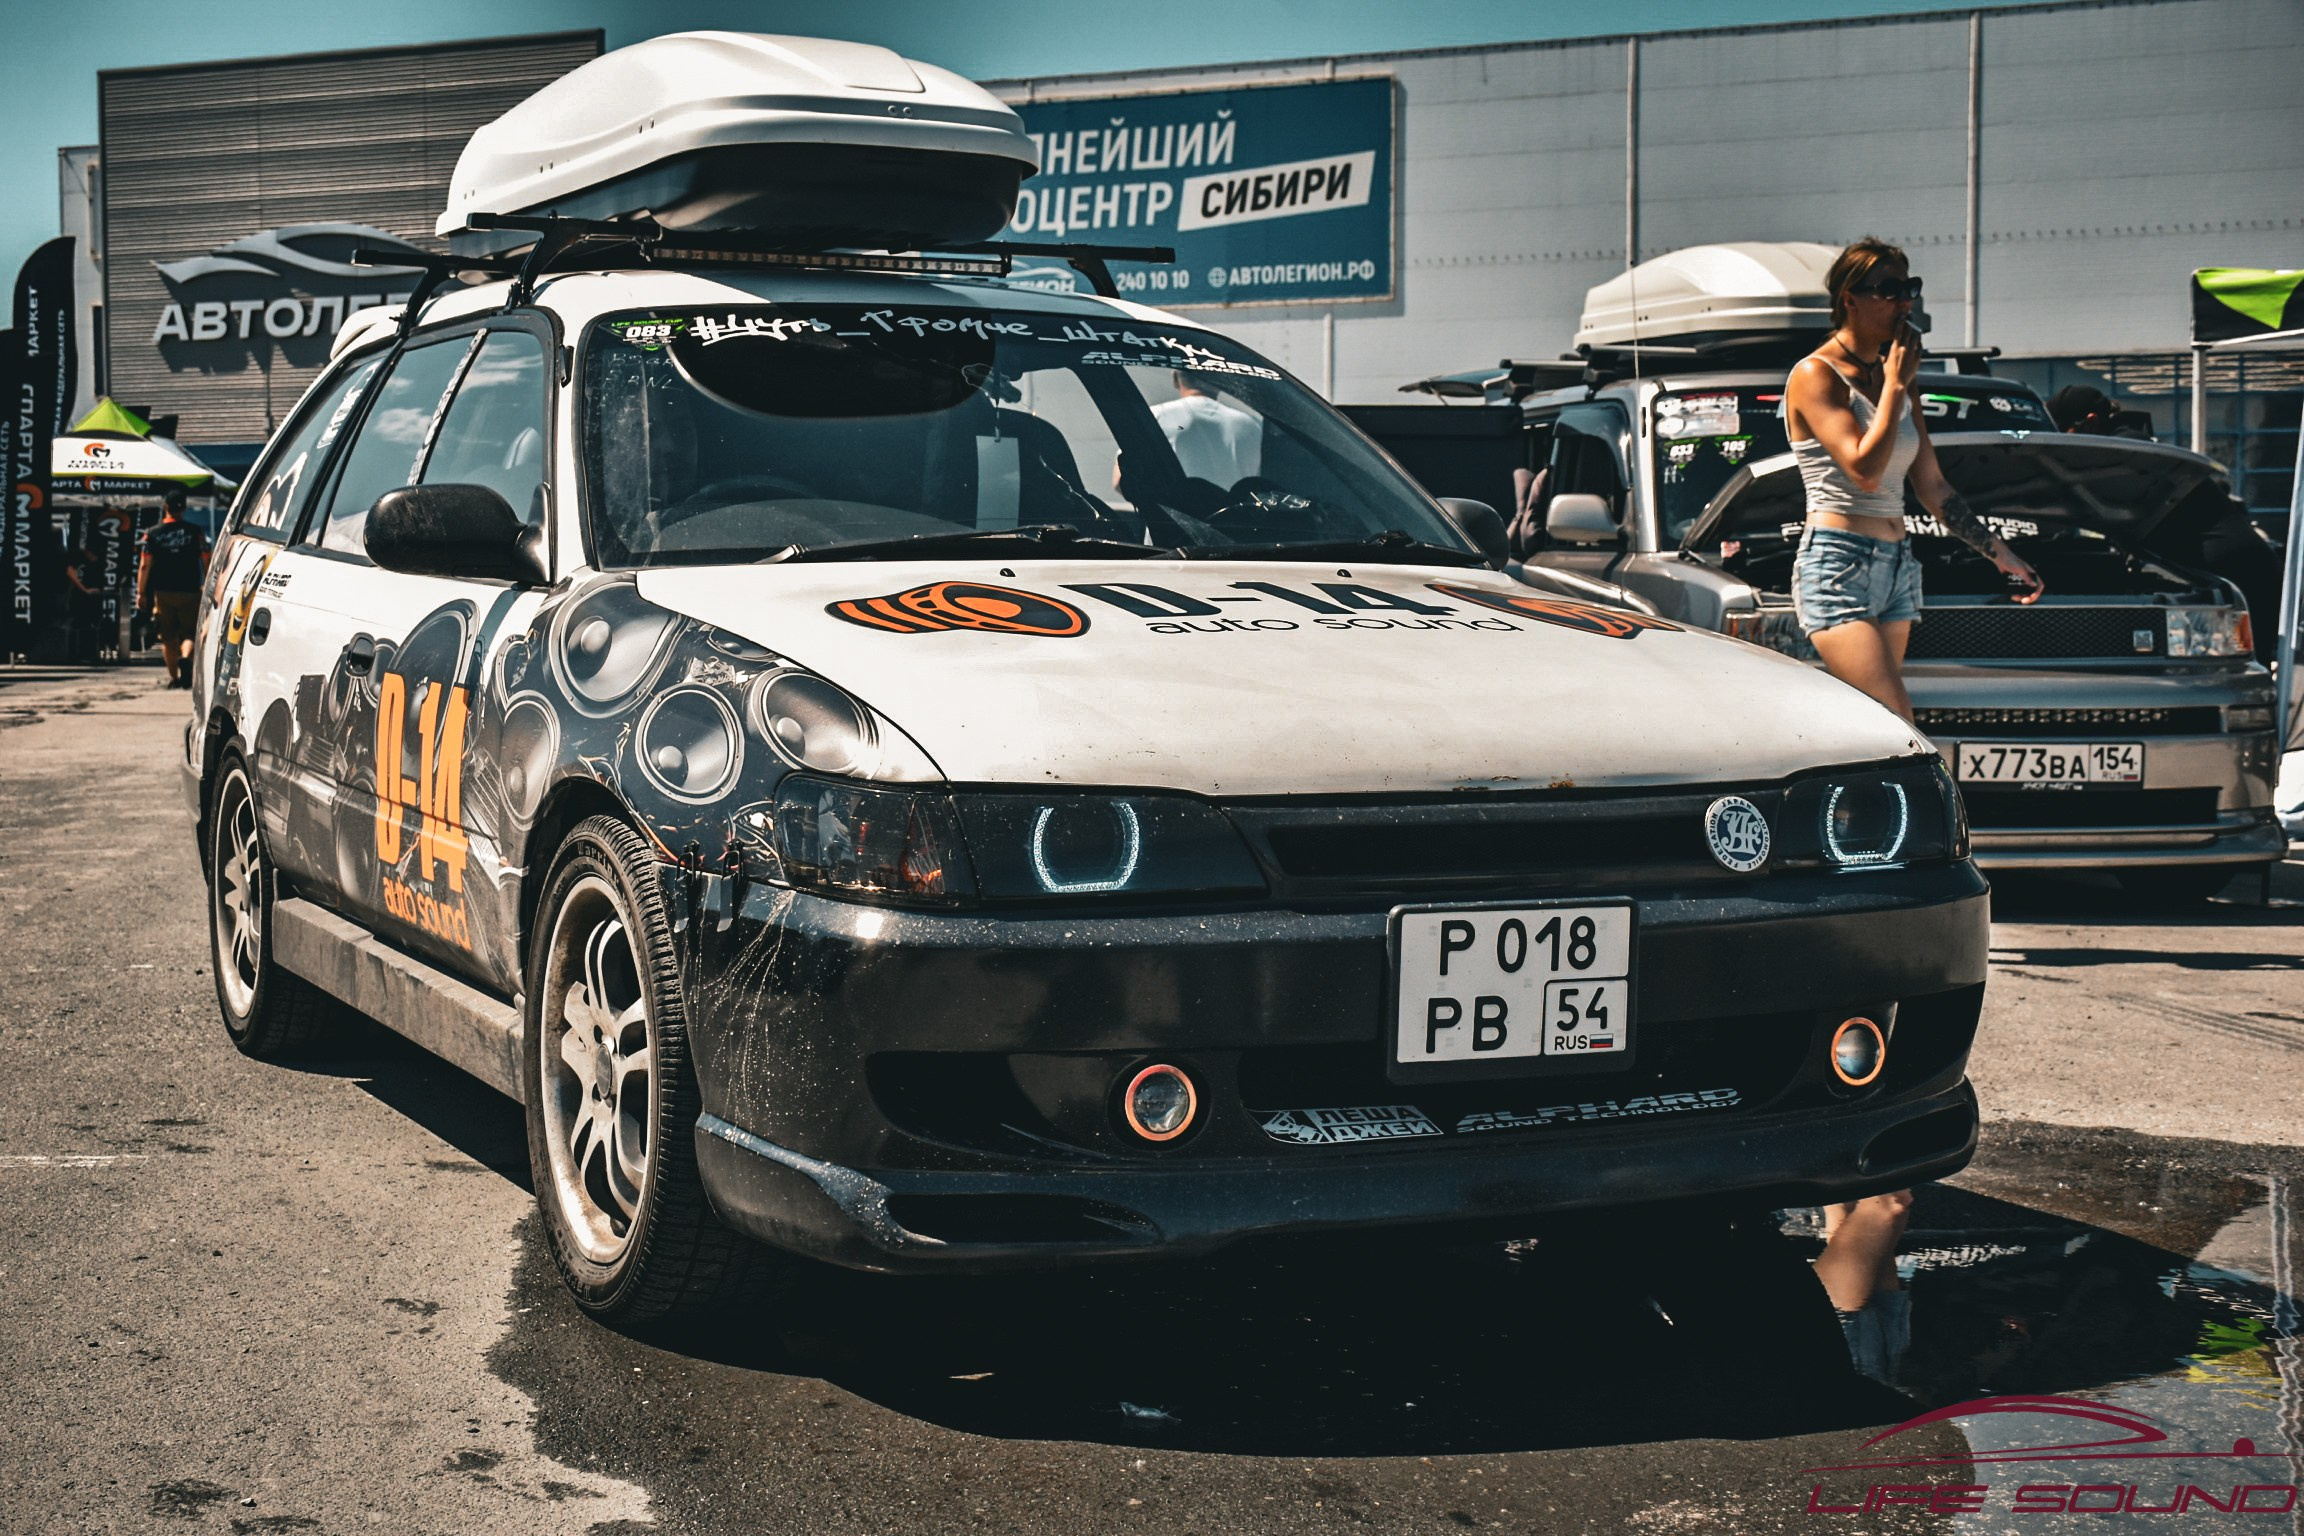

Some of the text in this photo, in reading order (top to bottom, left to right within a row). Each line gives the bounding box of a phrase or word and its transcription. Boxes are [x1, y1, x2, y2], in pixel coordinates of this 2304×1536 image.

[1201, 162, 1353, 219] СИБИРИ
[1116, 269, 1190, 292] 240 10 10
[1228, 260, 1375, 288] АВТОЛЕГИОН.РФ
[57, 309, 66, 332] СЕТЬ
[626, 324, 672, 338] 083
[1081, 351, 1280, 378] ALPHARD
[104, 481, 151, 490] МАРКЕТ
[14, 522, 32, 624] МАРКЕТ
[1145, 617, 1525, 634] auto sound
[2093, 746, 2135, 771] 154
[1721, 798, 1752, 810] JAPAN
[1709, 812, 1739, 868] FEDERATION
[1747, 817, 1770, 869] AUTOMOBILE
[383, 876, 472, 950] auto sound
[1496, 915, 1597, 973] 018
[1556, 986, 1609, 1032] 54
[1554, 1034, 1589, 1051] RUS
[1456, 1087, 1739, 1127] ALPHARD
[1457, 1096, 1743, 1134] SOUND TECHNOLOGY
